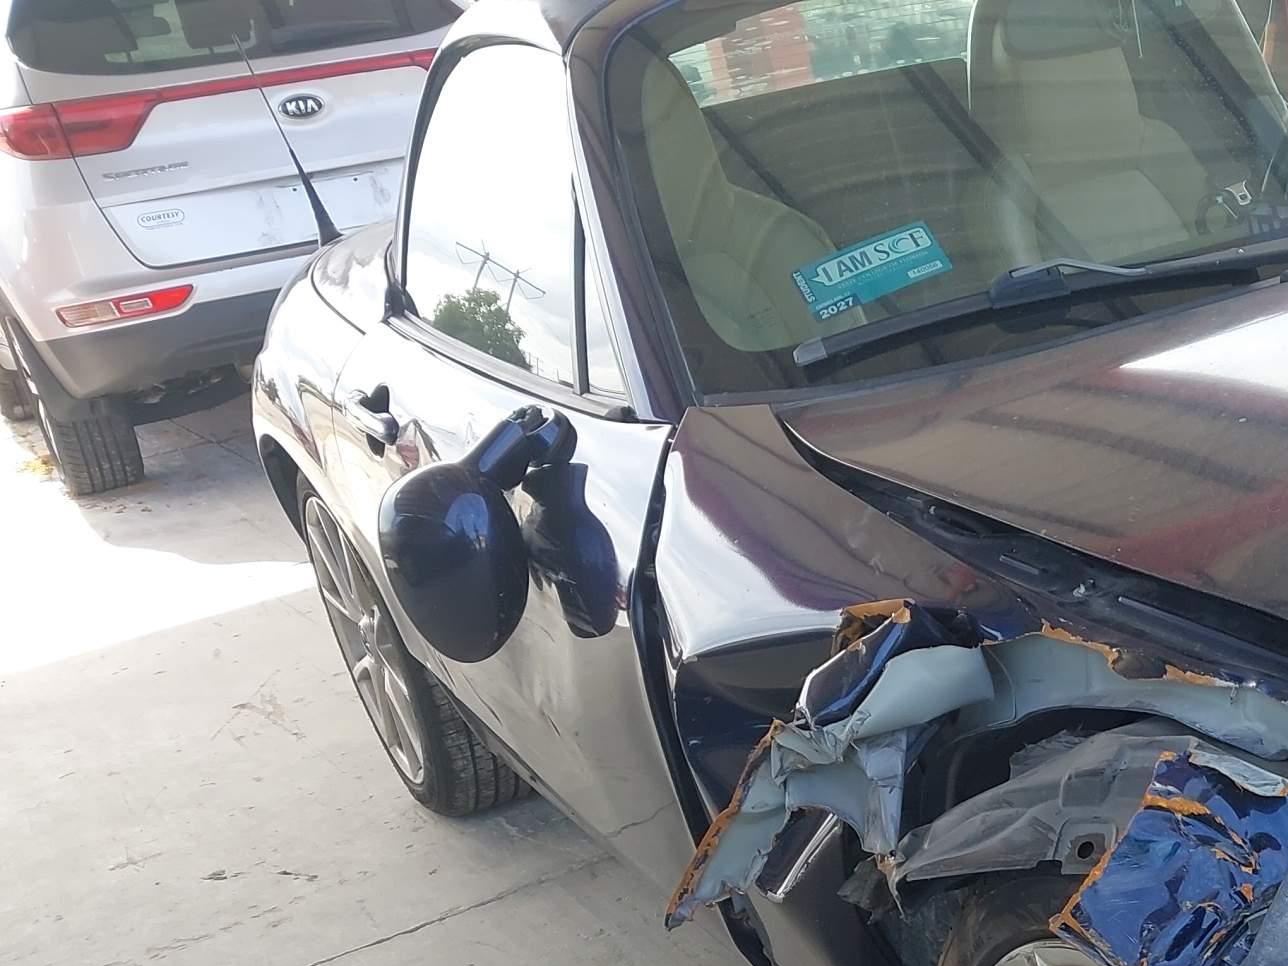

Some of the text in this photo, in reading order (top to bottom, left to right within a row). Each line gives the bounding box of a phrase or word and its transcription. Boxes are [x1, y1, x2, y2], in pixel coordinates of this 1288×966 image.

[285, 98, 320, 116] KIA
[140, 211, 180, 223] COURTESY
[822, 266, 834, 283] I
[837, 250, 873, 279] AM
[792, 271, 817, 303] STUDENT
[819, 296, 854, 320] 2027
